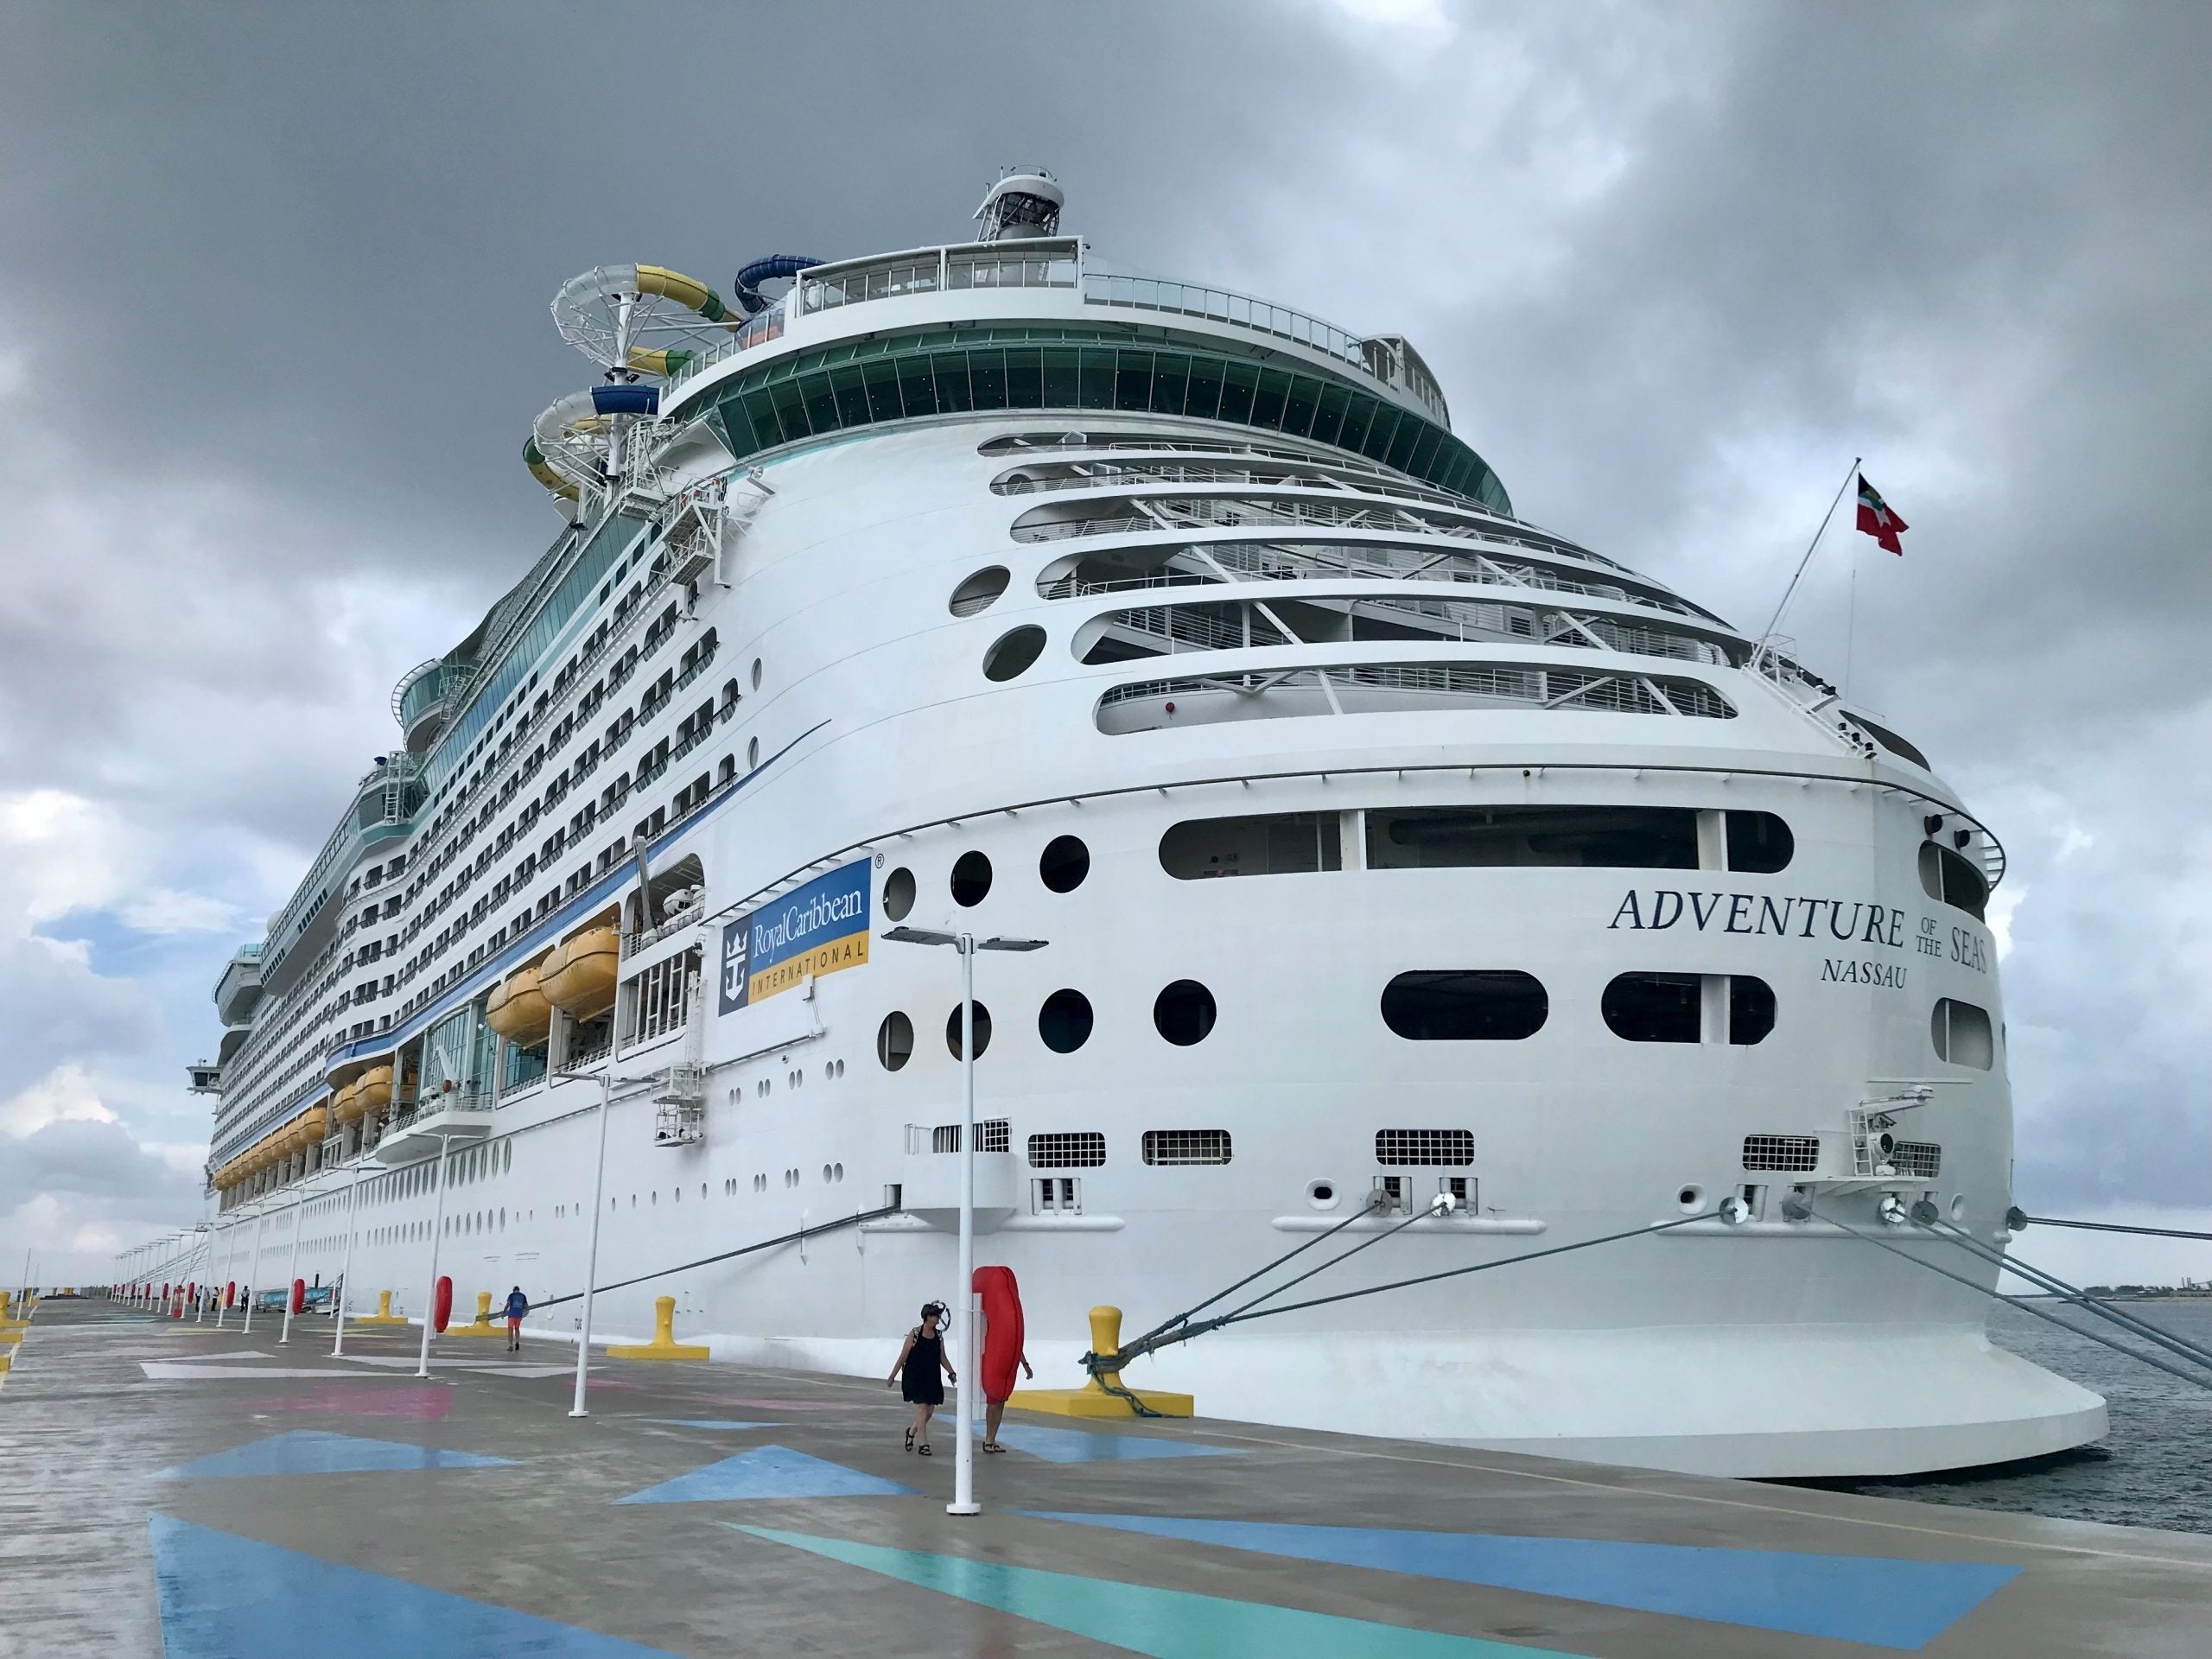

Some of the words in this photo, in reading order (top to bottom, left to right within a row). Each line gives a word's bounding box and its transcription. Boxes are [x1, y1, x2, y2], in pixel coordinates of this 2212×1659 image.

[1606, 889, 1904, 948] ADVENTURE
[1921, 917, 1937, 936] OF
[1916, 935, 1942, 957] THE
[1950, 926, 1986, 974] SEAS
[752, 940, 864, 995] INTERNATIONAL
[1821, 958, 1907, 988] NASSAU
